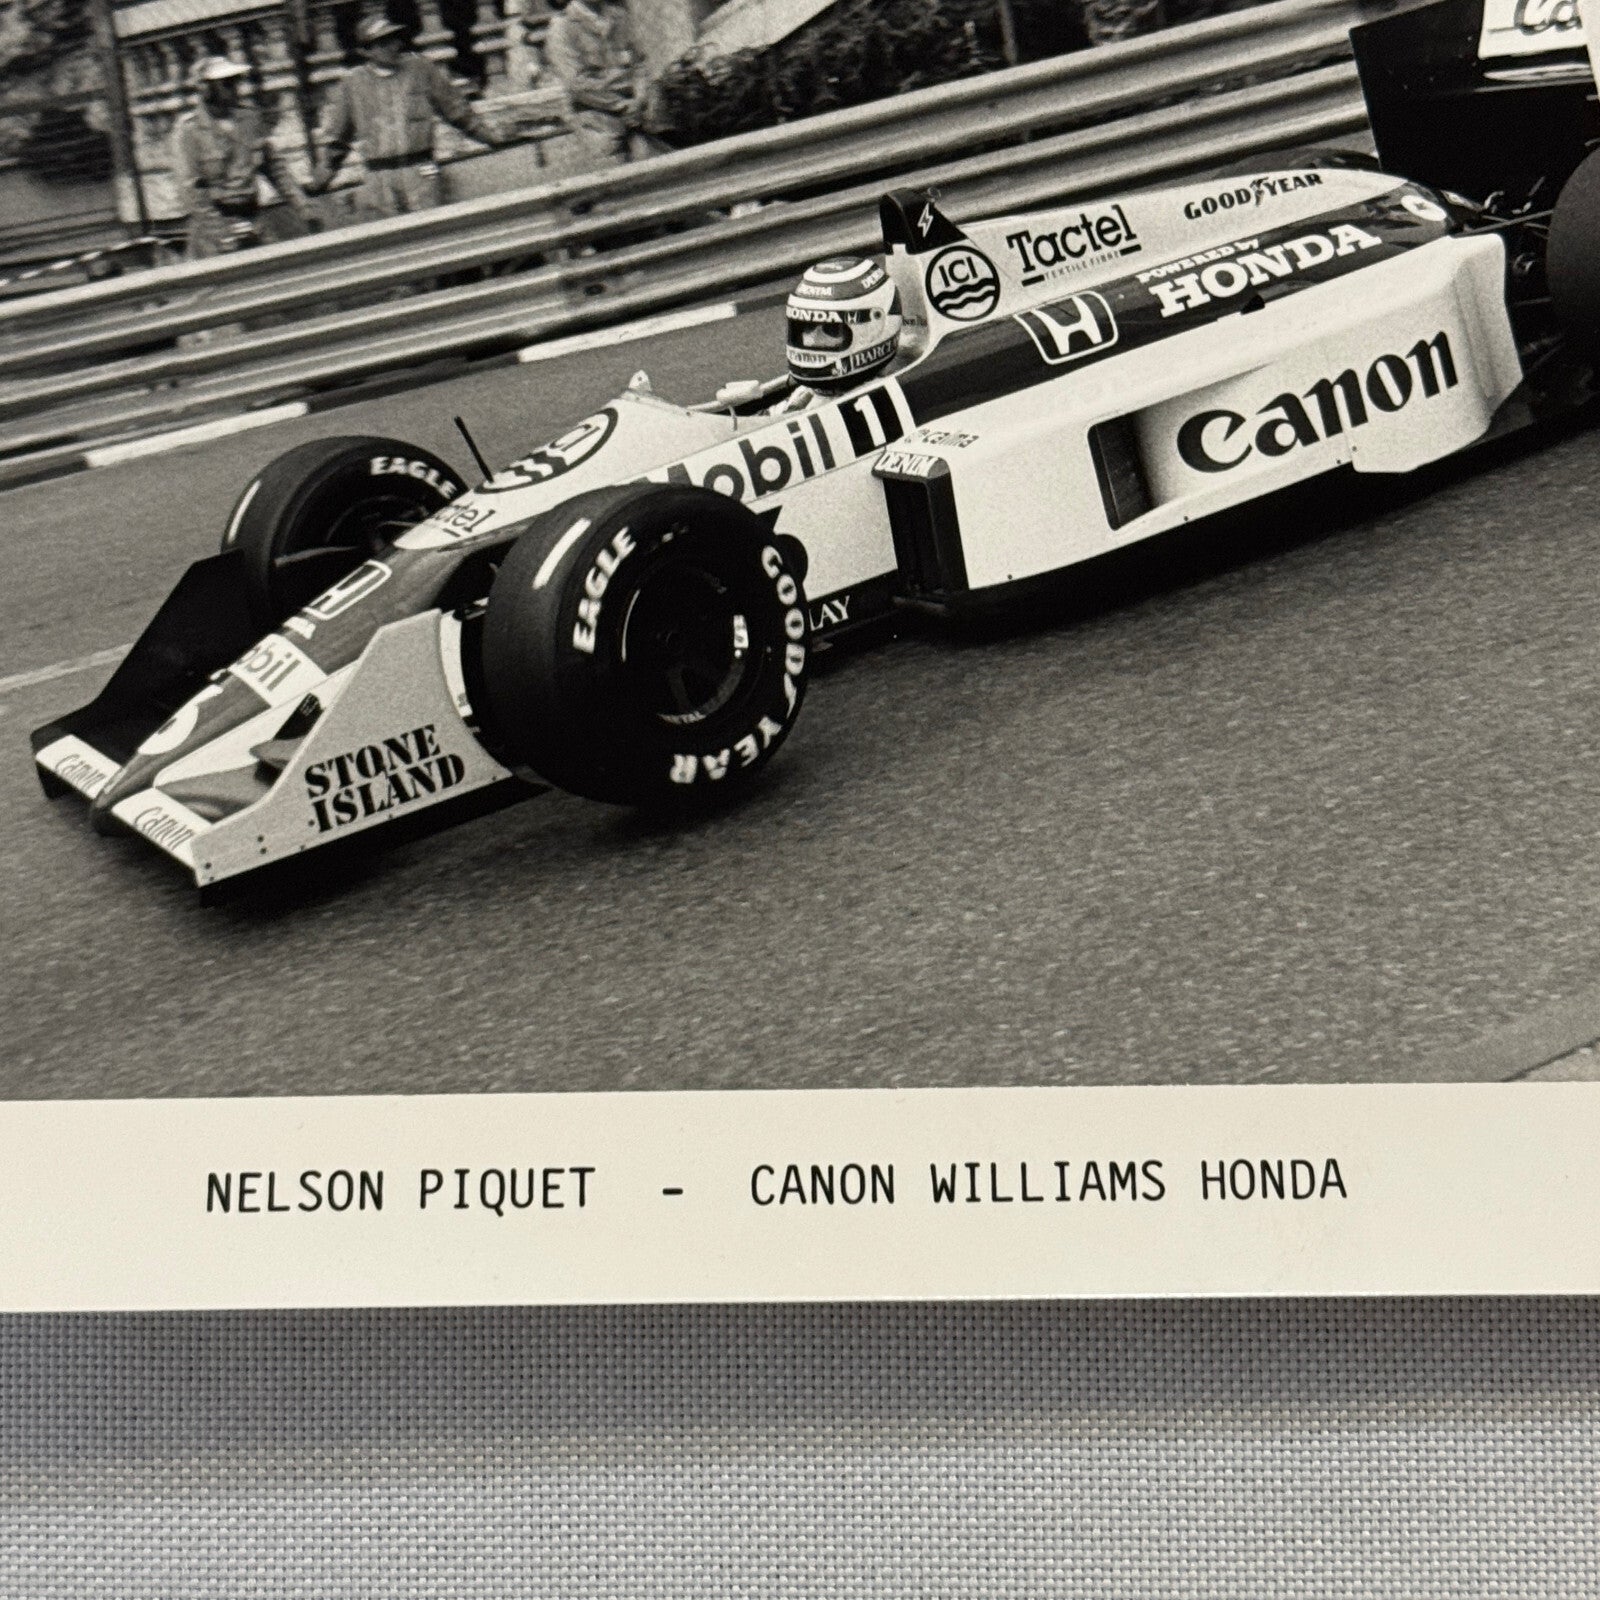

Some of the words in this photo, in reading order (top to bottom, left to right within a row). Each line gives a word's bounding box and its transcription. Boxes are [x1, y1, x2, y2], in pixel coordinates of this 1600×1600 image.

[1183, 173, 1323, 220] GOODYEAR
[1006, 204, 1138, 273] Tactel
[1148, 223, 1383, 318] HONDA
[938, 256, 979, 288] ICI
[854, 394, 887, 449] 1
[1176, 330, 1460, 474] Canon
[370, 456, 458, 500] EAGLE
[572, 526, 637, 655] EAGLE
[808, 595, 851, 622] LAY
[304, 723, 441, 799] STONE
[312, 753, 466, 833] ISLAND
[207, 1169, 384, 1213] NELSON
[420, 1167, 596, 1217] PIQUET
[662, 1188, 684, 1196] -
[751, 1163, 895, 1206] CANON
[930, 1159, 1166, 1203] WILLIAMS
[1201, 1158, 1347, 1201] HONDA
